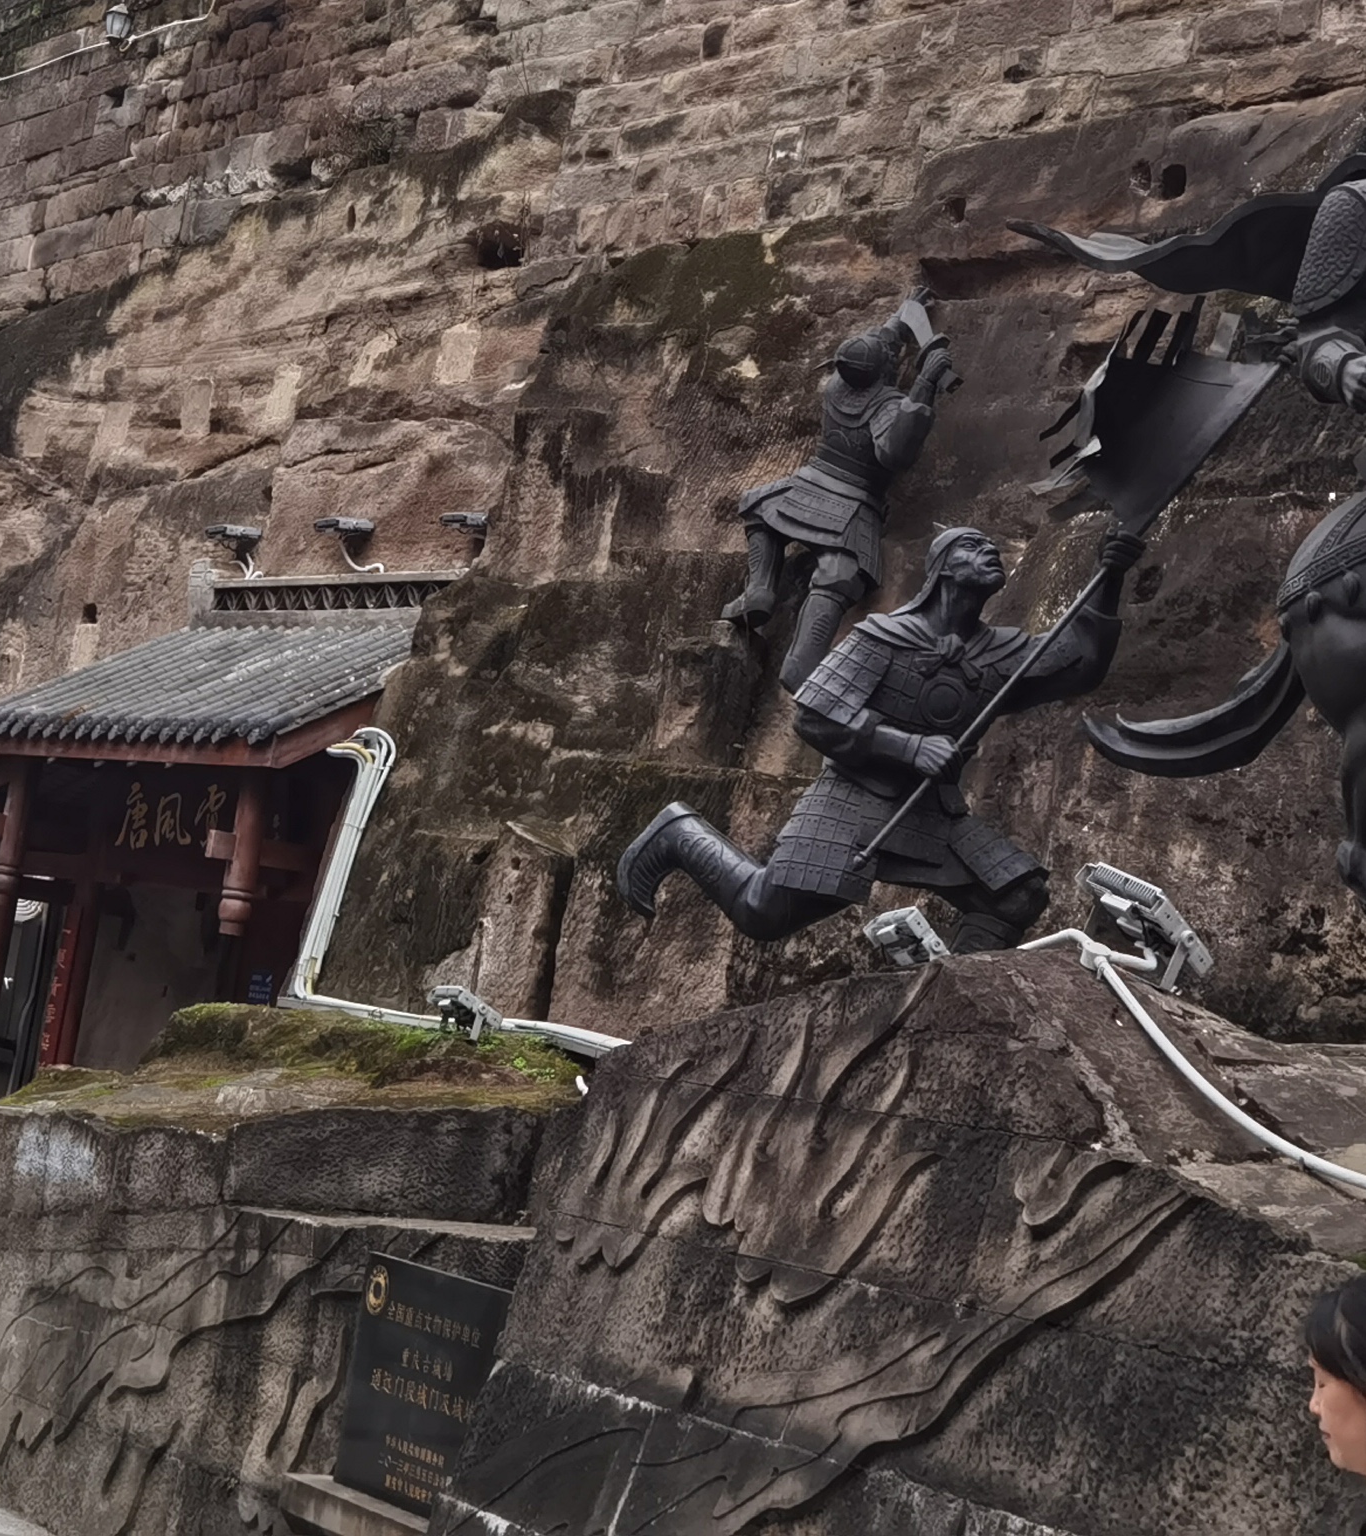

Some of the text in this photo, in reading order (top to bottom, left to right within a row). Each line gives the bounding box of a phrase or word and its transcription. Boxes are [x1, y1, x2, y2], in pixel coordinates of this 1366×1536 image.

[386, 1300, 481, 1349] 全国重点文物保护单位
[402, 1347, 453, 1382] 重庆古城墙
